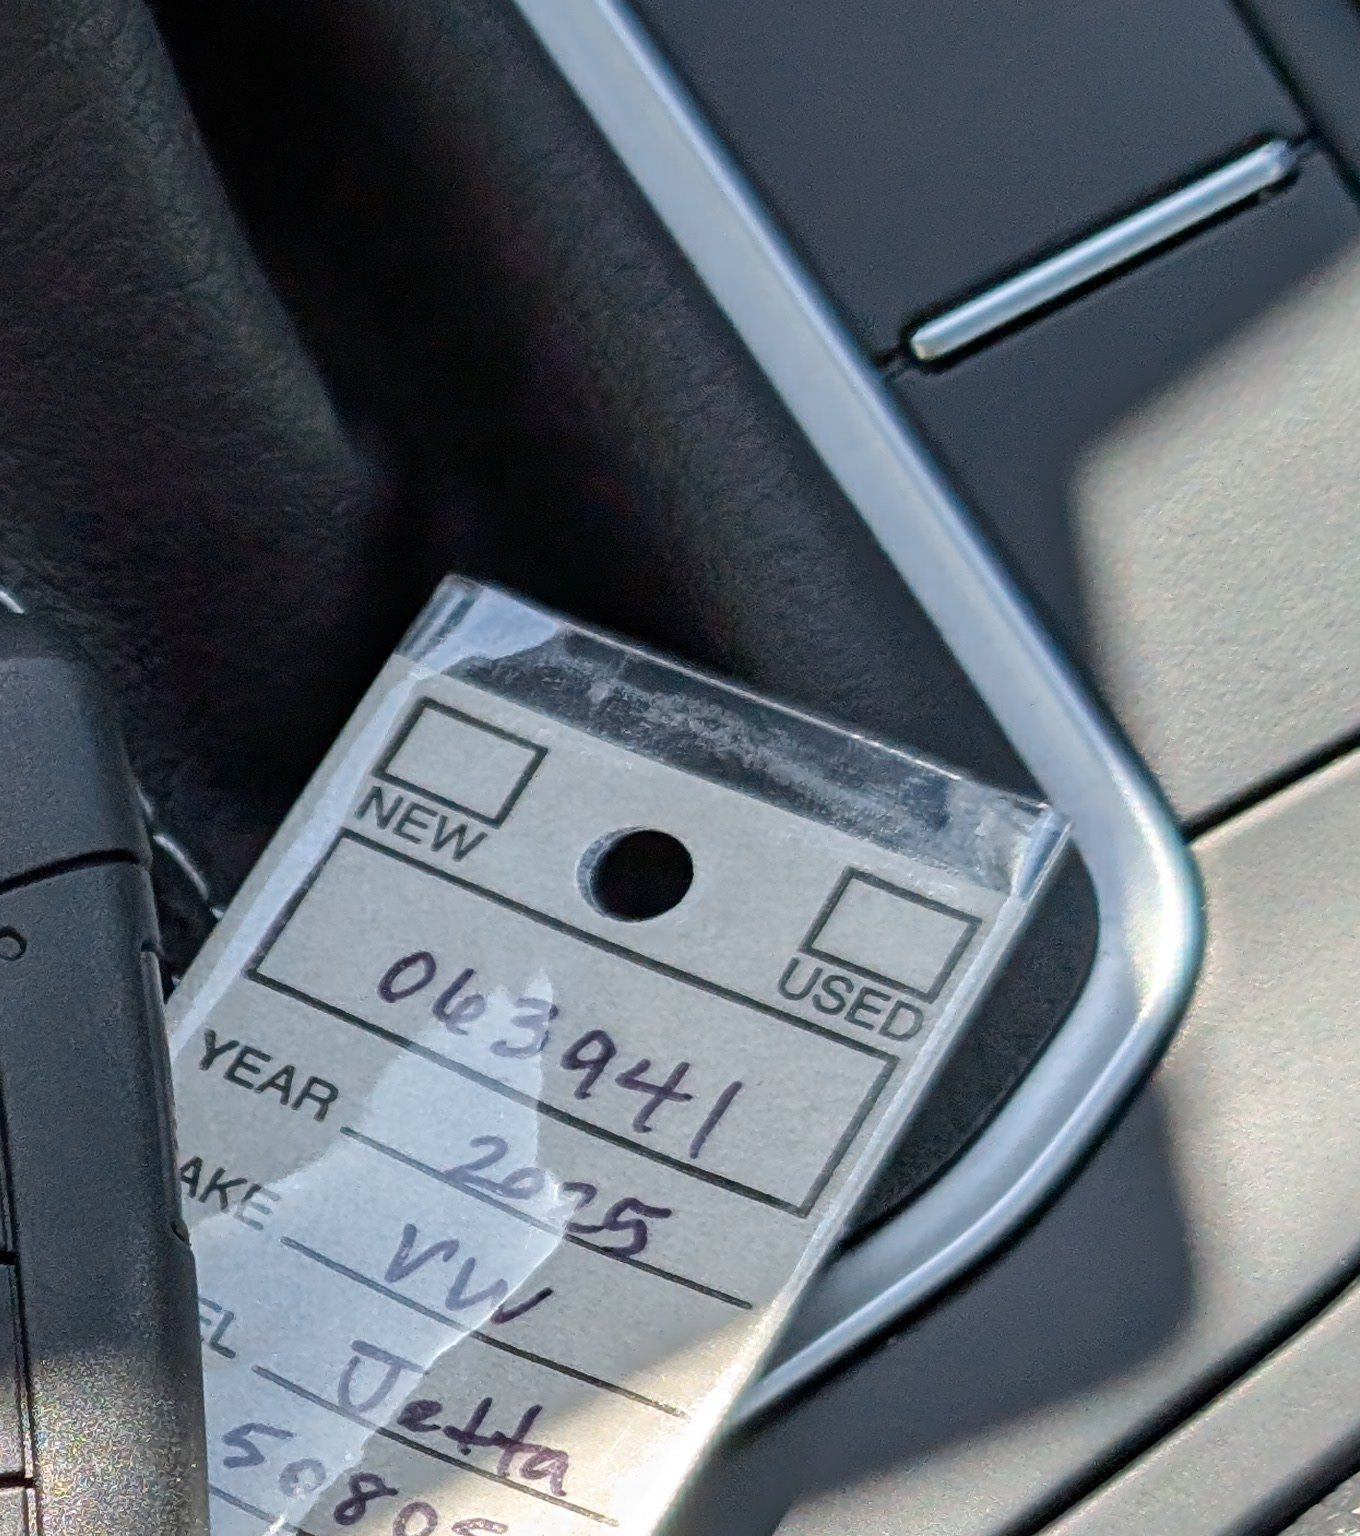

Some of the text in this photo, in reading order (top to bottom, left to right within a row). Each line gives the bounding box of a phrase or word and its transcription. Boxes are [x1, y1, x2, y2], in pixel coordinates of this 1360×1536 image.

[355, 788, 486, 863] NEW
[776, 958, 925, 1044] USED
[199, 1030, 340, 1122] YEAR
[377, 949, 742, 1159] 063941
[179, 1156, 280, 1231] AKE
[442, 1136, 671, 1258] 2025
[383, 1223, 553, 1323] VW
[338, 1340, 569, 1497] Jetta
